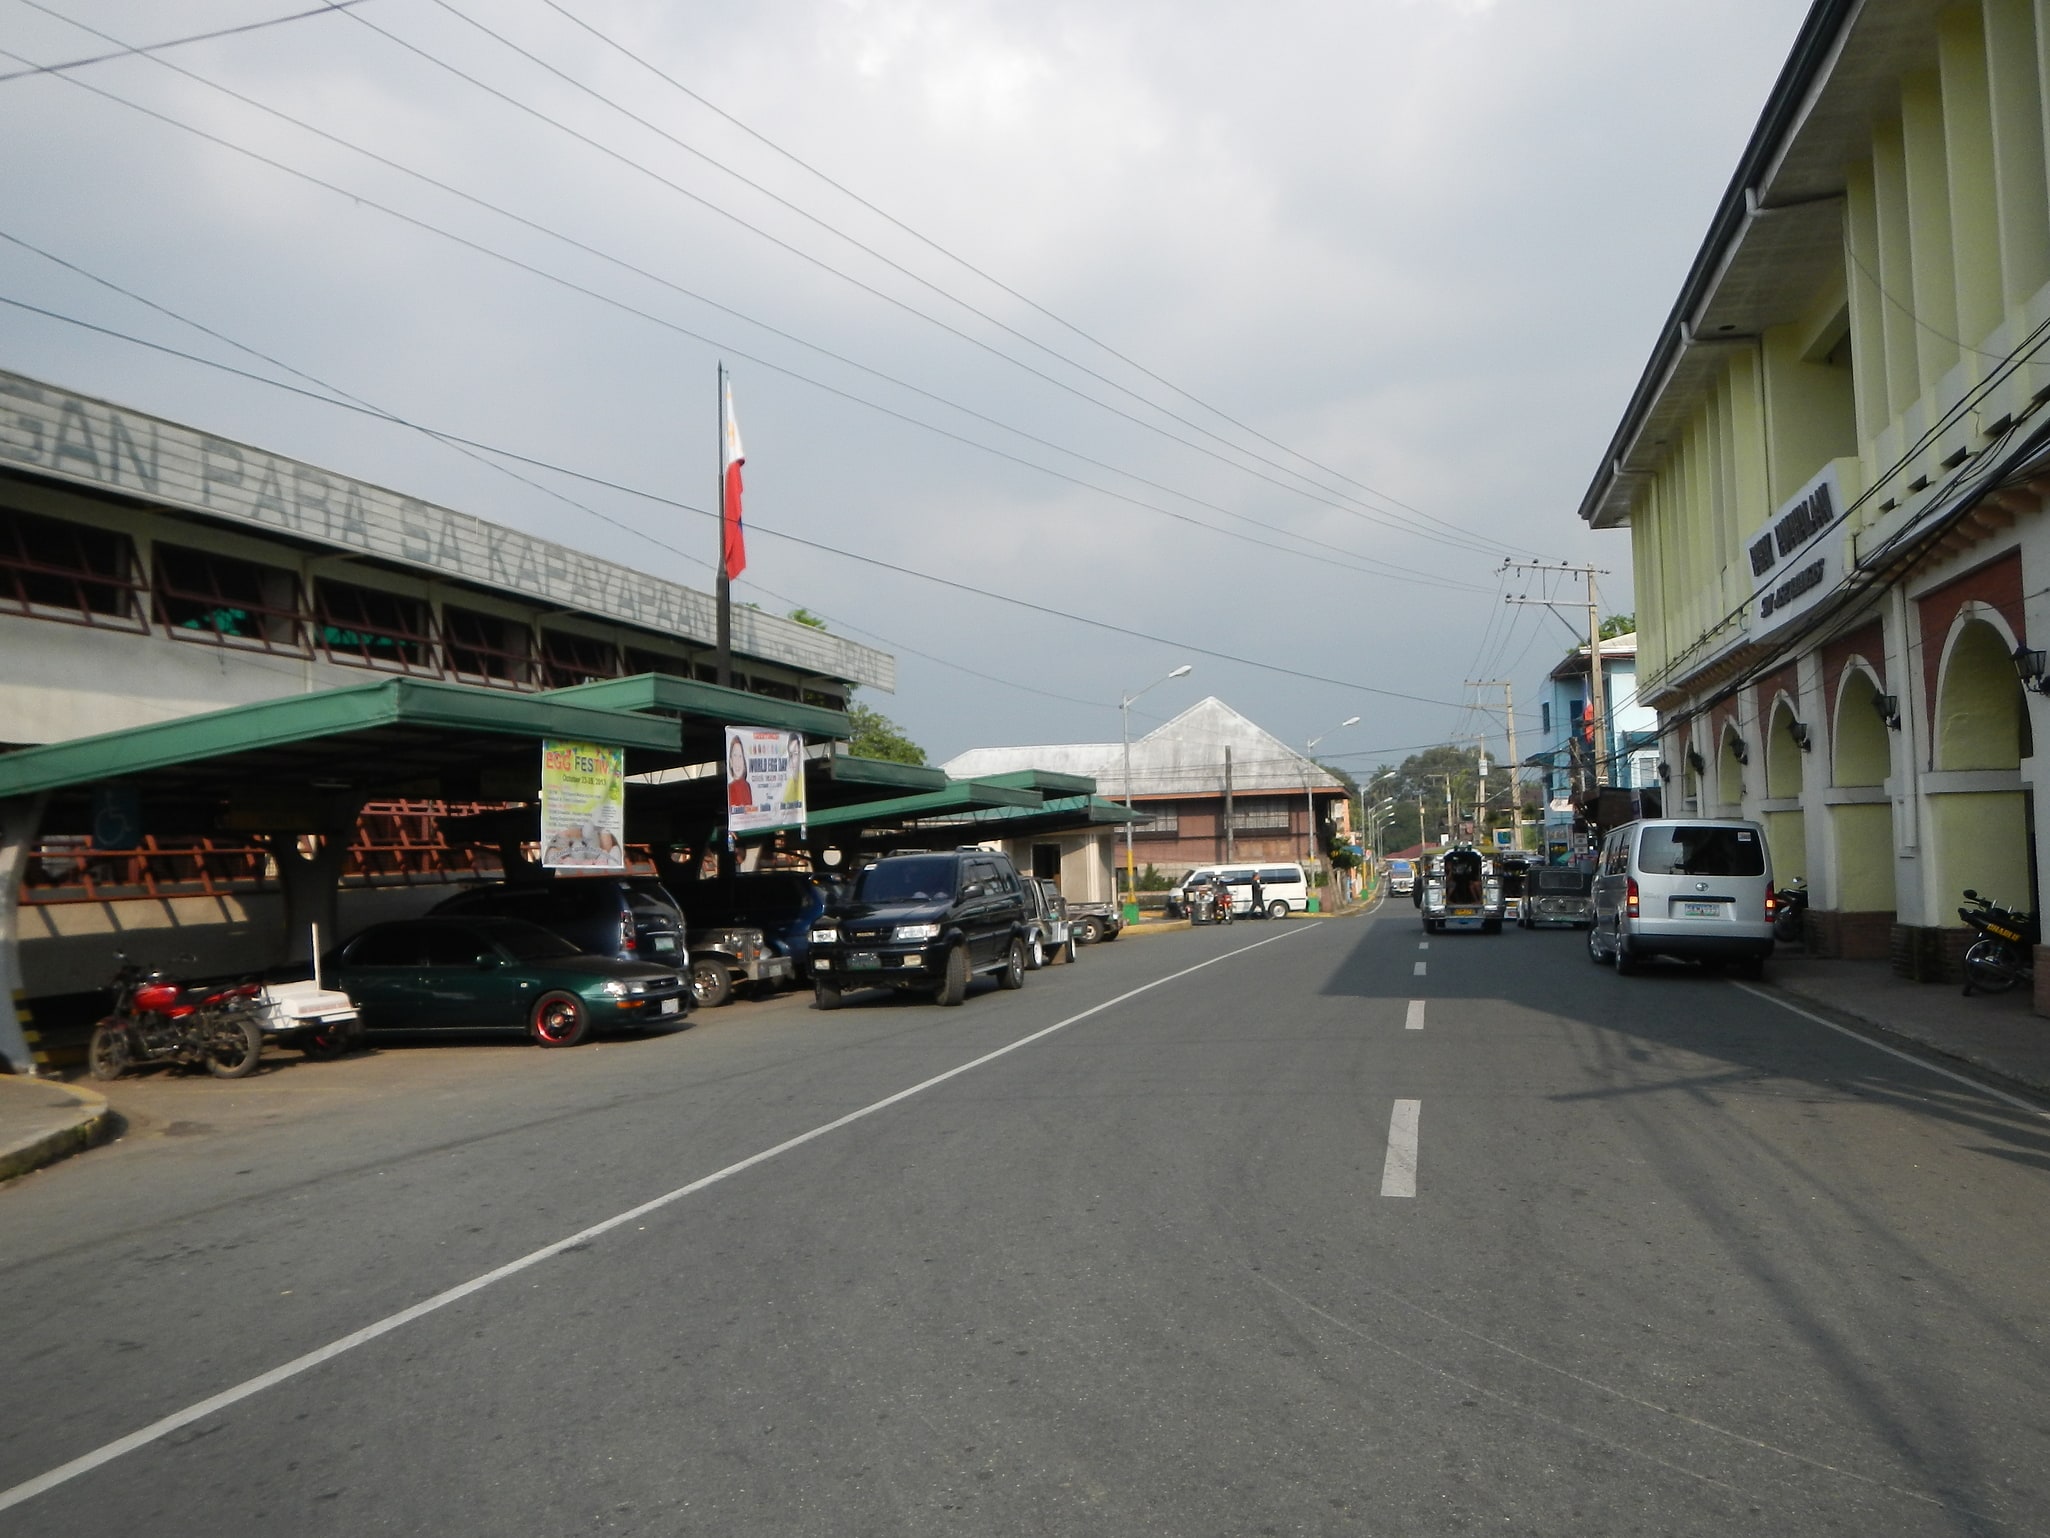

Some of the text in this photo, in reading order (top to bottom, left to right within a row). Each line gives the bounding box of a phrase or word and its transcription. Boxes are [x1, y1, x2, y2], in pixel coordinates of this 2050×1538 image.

[202, 438, 371, 549] PARA
[401, 500, 463, 573] SA
[487, 526, 713, 638] KAPAYAPAAN
[546, 750, 572, 773] EGG
